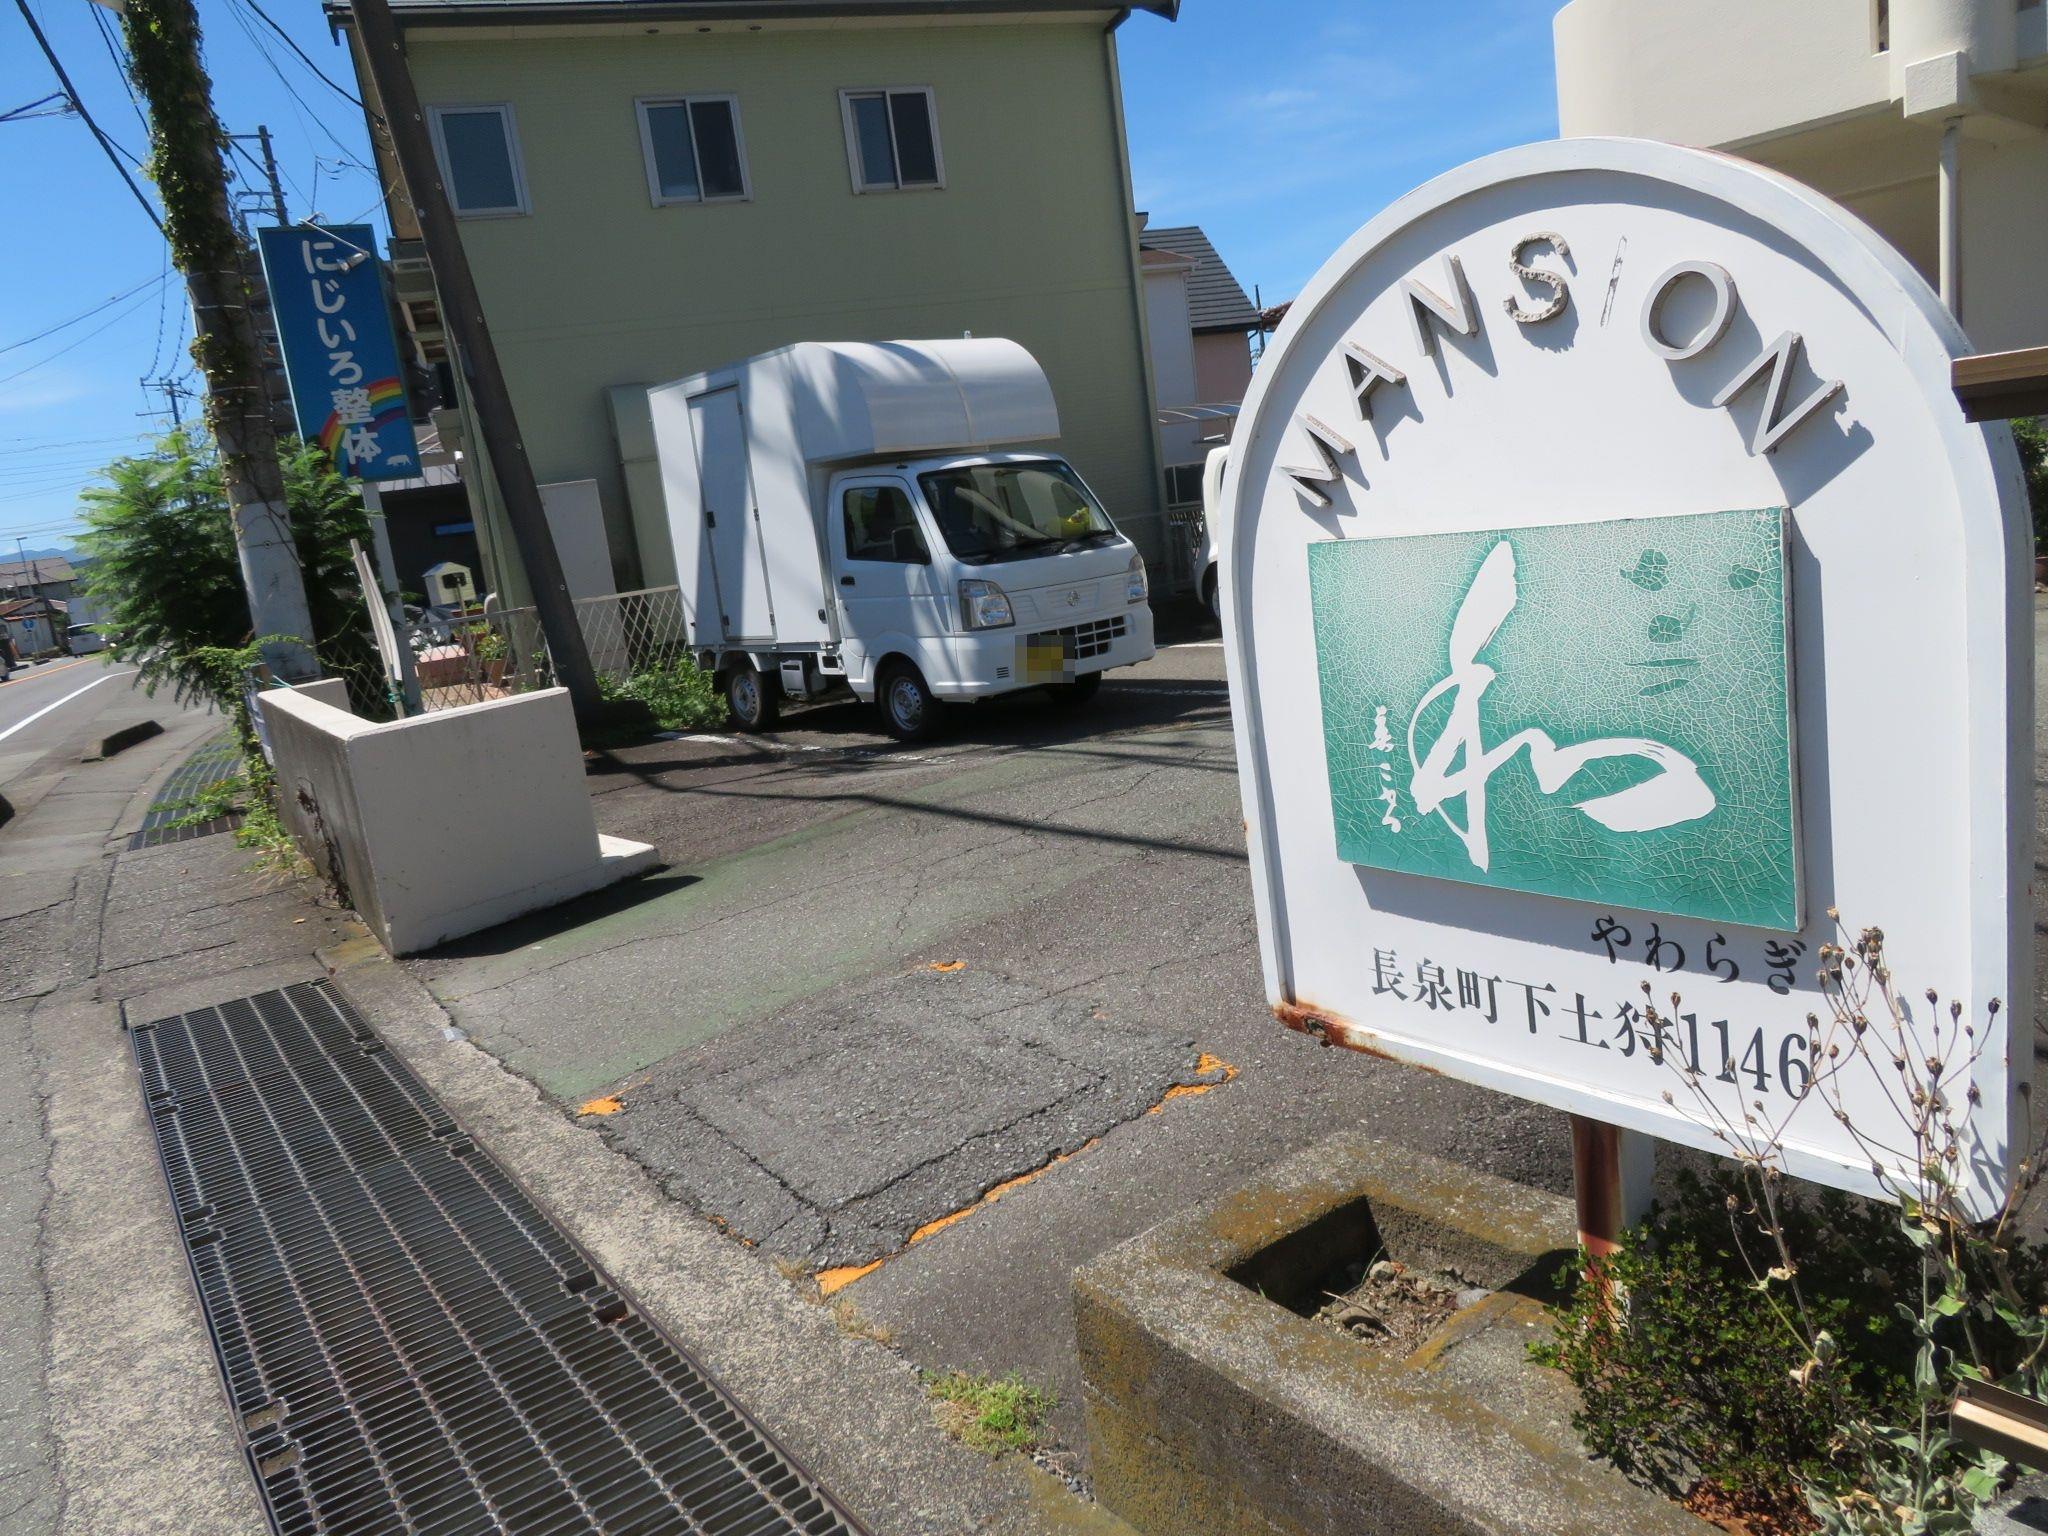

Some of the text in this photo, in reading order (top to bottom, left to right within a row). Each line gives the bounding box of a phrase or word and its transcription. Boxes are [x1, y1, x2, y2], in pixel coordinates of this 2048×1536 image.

[303, 239, 381, 464] にじいろ整体
[1278, 231, 1846, 507] MANSION
[1591, 915, 1807, 996] やわらぎ
